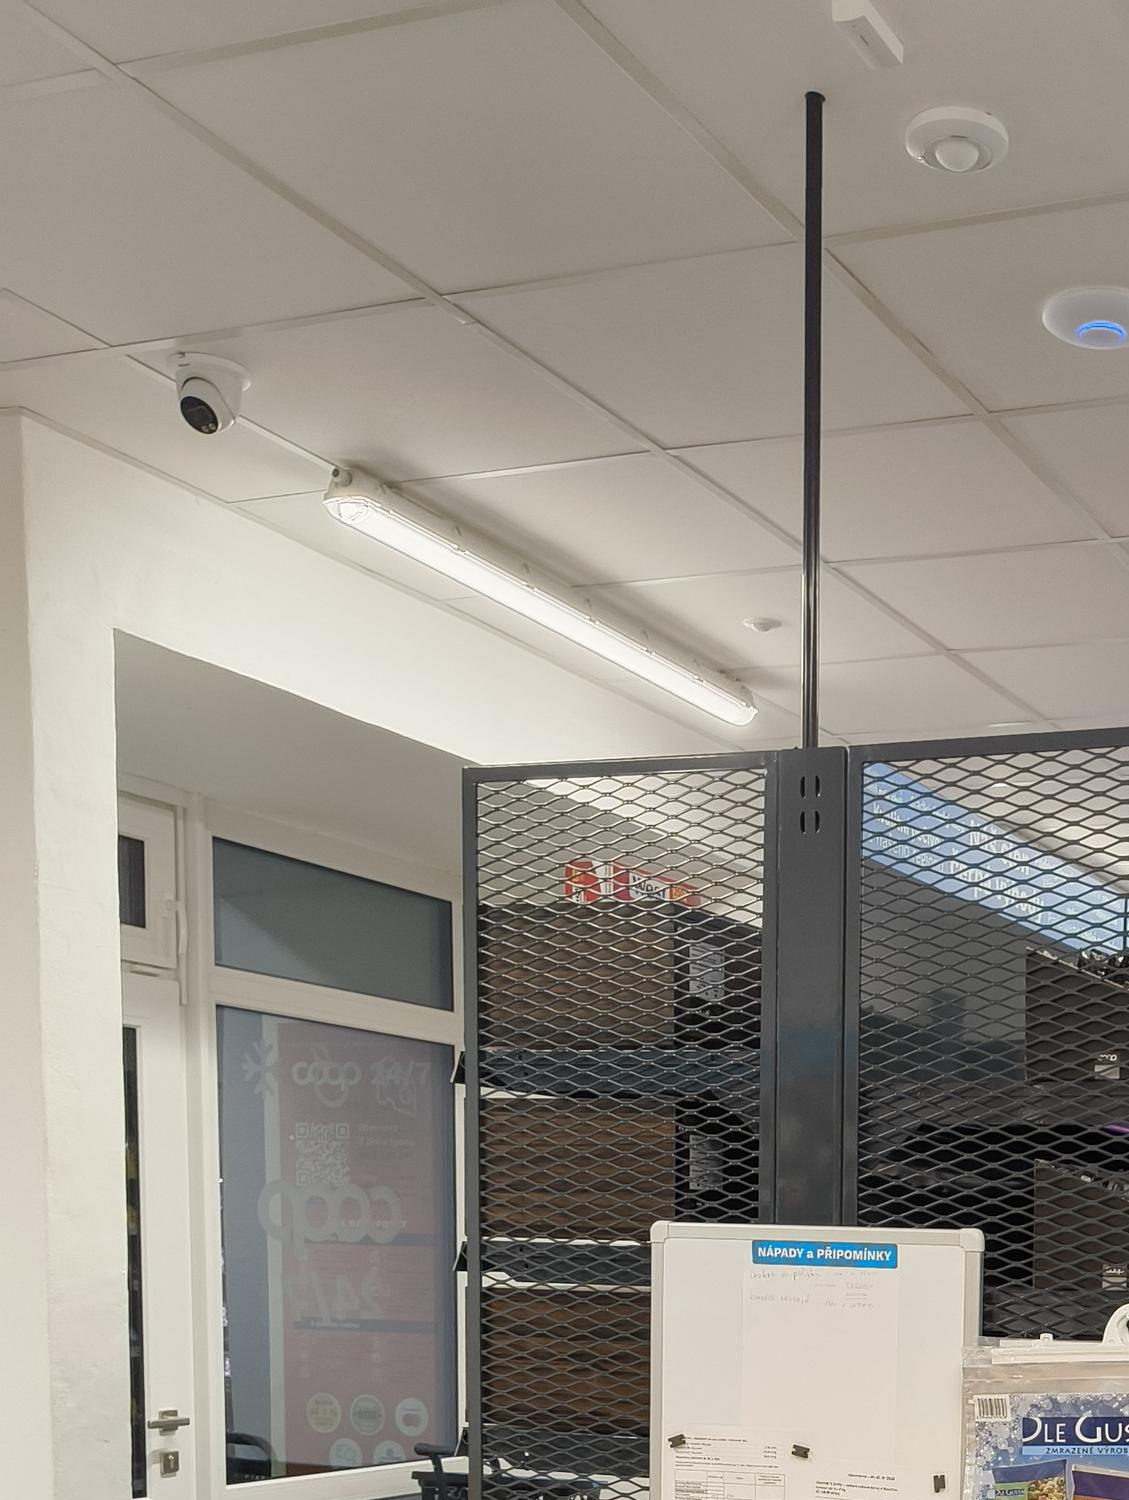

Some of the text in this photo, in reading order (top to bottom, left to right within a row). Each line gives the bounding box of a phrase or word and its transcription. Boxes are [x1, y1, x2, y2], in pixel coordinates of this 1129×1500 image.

[757, 1246, 892, 1261] NÁPADY a PŘIPOMÍNKY
[1045, 1446, 1094, 1455] ZMRAZENÉ
